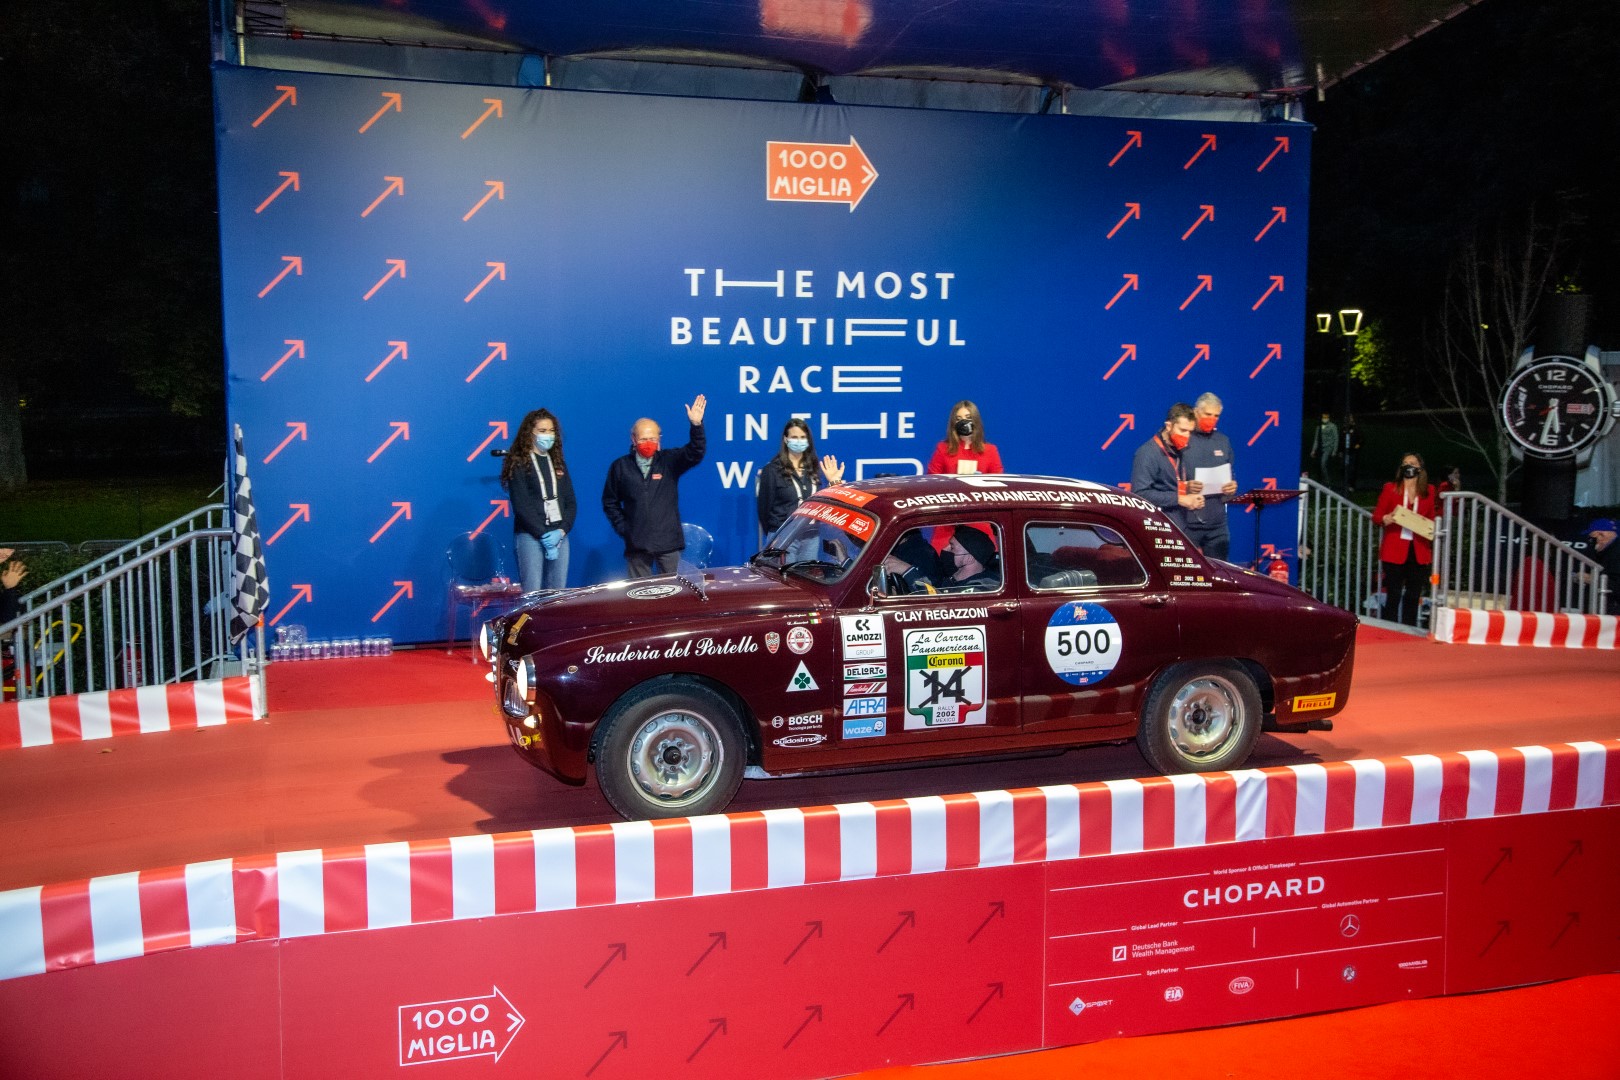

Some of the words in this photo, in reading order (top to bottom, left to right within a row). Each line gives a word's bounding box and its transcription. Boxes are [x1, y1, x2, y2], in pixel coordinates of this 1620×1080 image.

[778, 149, 847, 170] 1000
[773, 176, 852, 197] MIGLIA
[684, 268, 814, 298] THE
[836, 271, 955, 300] MOST
[671, 317, 966, 346] BEAUTIFUL
[739, 365, 903, 393] RACE
[1547, 370, 1566, 380] 12
[725, 413, 769, 441] IN
[893, 490, 973, 509] CARRERA
[895, 611, 923, 623] CLAY
[926, 607, 989, 622] REGAZZONI
[846, 633, 882, 642] CAMOZZI
[916, 633, 931, 644] La
[935, 632, 975, 643] Carrera
[1058, 629, 1110, 656] 500
[584, 646, 661, 664] Scuderia
[664, 640, 691, 658] del
[694, 636, 759, 657] Portello
[911, 643, 981, 655] Panamericana
[928, 656, 964, 668] Corona
[924, 668, 966, 704] 14
[845, 698, 886, 715] AFRA
[1297, 697, 1332, 708] PIRELLI
[788, 714, 823, 726] BOSCH
[845, 726, 873, 735] waze
[1228, 867, 1247, 875] Sponsor
[1269, 862, 1296, 870] Timekeeper
[1183, 876, 1325, 908] CHOPARD
[1337, 899, 1362, 907] Automotive
[1132, 942, 1162, 951] Deutsche
[1132, 950, 1154, 958] Wealth
[1155, 945, 1195, 956] Management
[1165, 988, 1182, 1000] FIA
[1086, 1000, 1113, 1008] SPORT
[412, 1004, 489, 1030] 1000
[407, 1030, 495, 1058] MIGLIA
